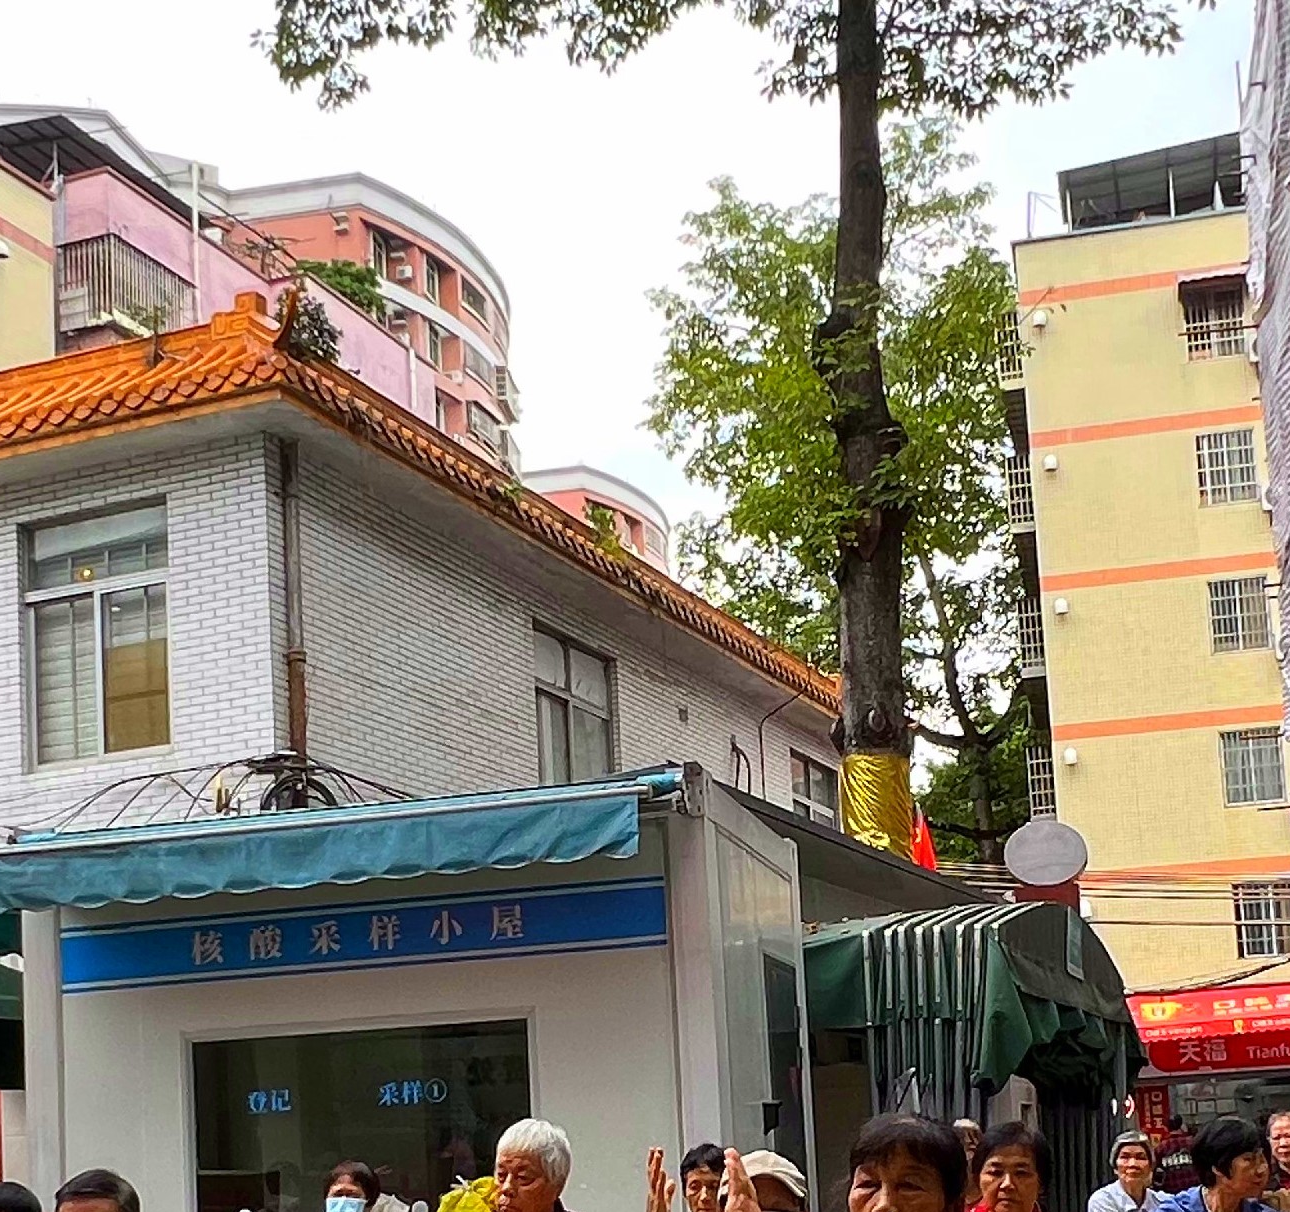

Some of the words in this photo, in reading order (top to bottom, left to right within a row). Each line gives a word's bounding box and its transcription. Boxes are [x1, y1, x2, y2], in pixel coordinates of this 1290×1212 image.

[191, 904, 525, 966] 核酸采样小屋
[1178, 1038, 1227, 1064] 天福
[246, 1088, 293, 1115] 登记
